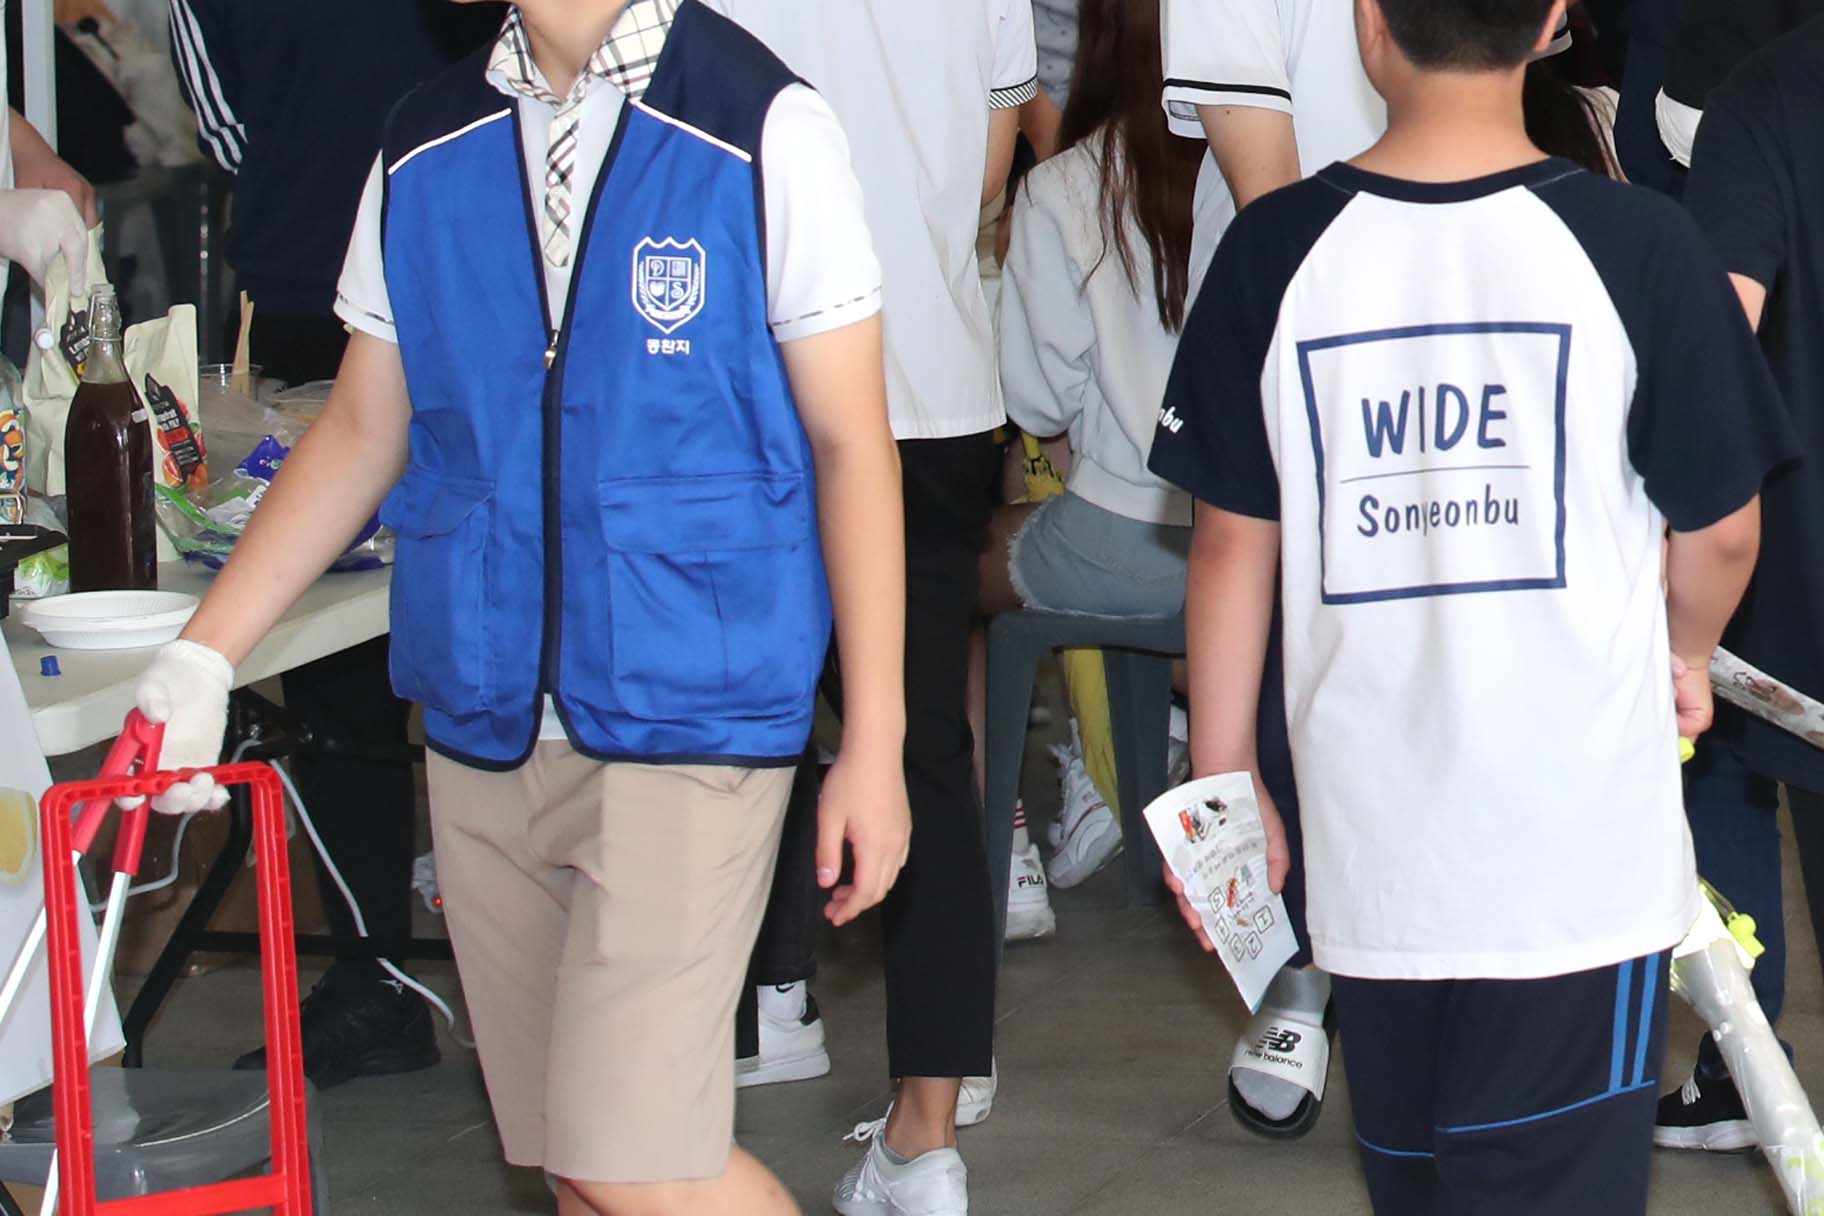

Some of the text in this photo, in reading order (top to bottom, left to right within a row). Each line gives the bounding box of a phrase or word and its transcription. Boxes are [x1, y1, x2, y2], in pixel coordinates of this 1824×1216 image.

[1361, 383, 1507, 458] WIDE
[1357, 483, 1519, 537] Sonyeonbu
[1263, 1051, 1304, 1070] balance
